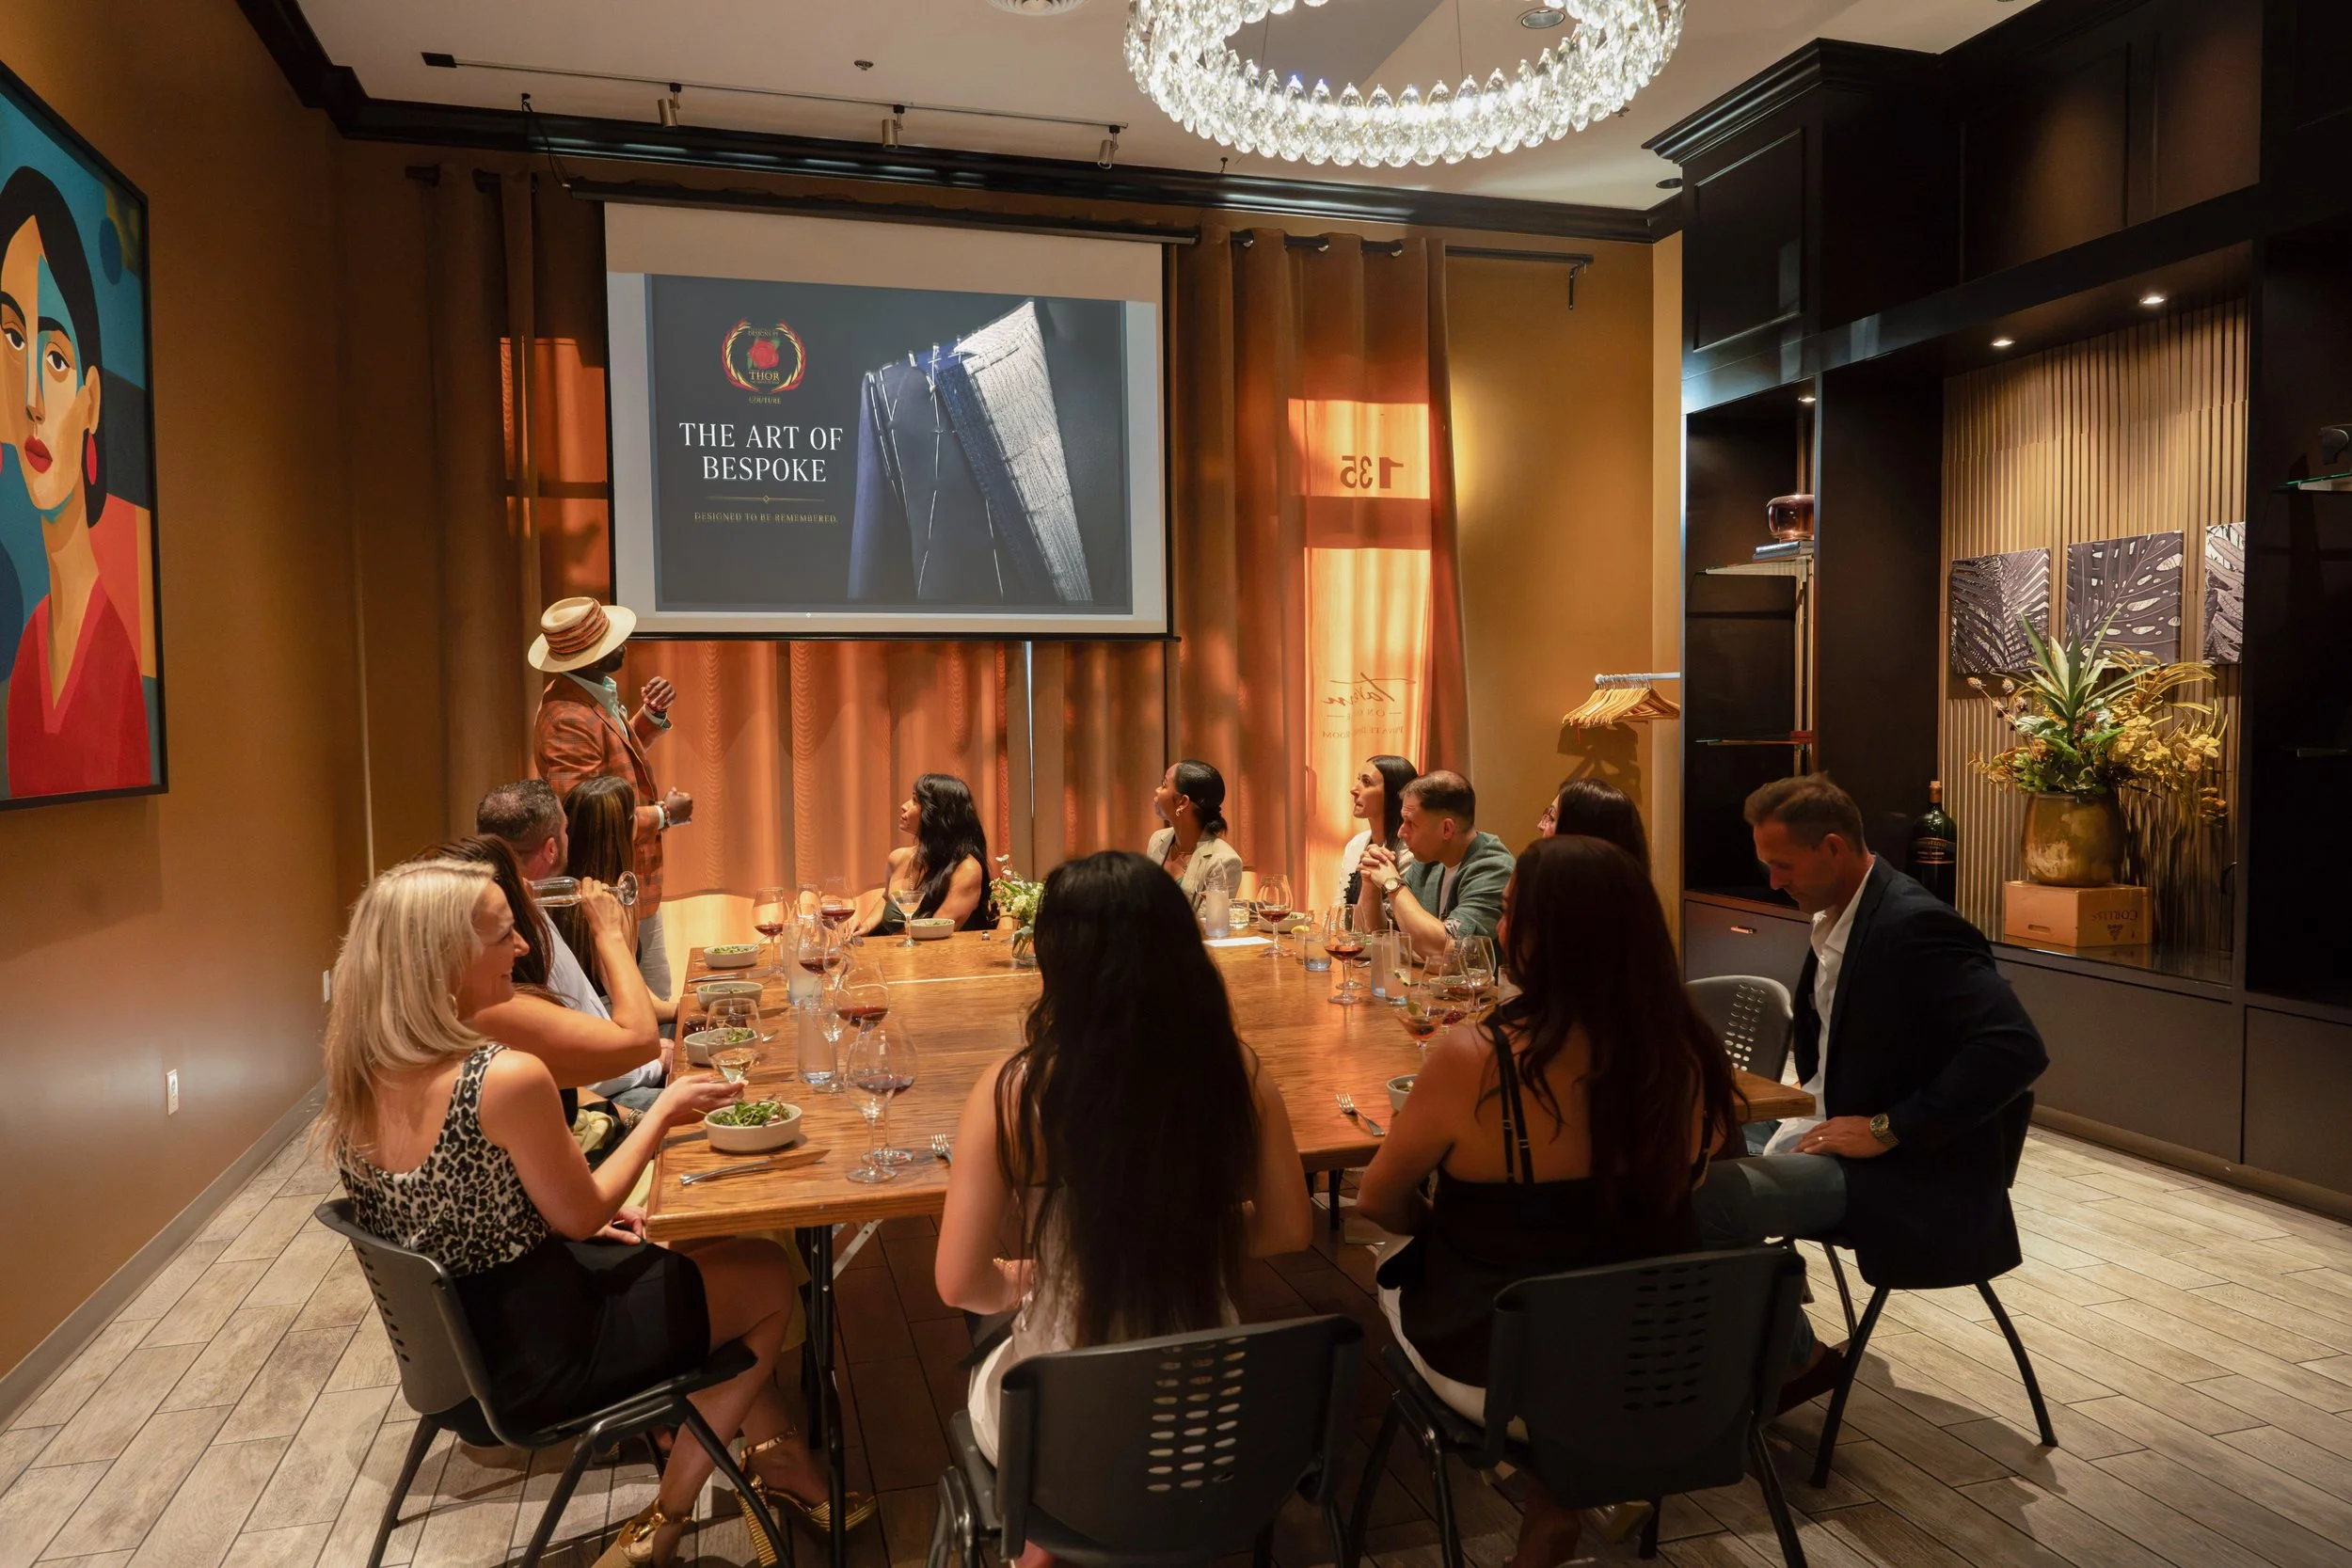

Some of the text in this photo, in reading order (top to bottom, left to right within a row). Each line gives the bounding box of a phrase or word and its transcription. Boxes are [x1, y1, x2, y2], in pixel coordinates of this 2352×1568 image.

[749, 371, 780, 381] THOR
[749, 395, 782, 405] COUTURE
[678, 422, 844, 451] THE ART OF
[702, 455, 827, 483] BESPOKE
[693, 512, 742, 522] DESIGNED
[744, 513, 757, 522] TO
[760, 514, 771, 523] BE
